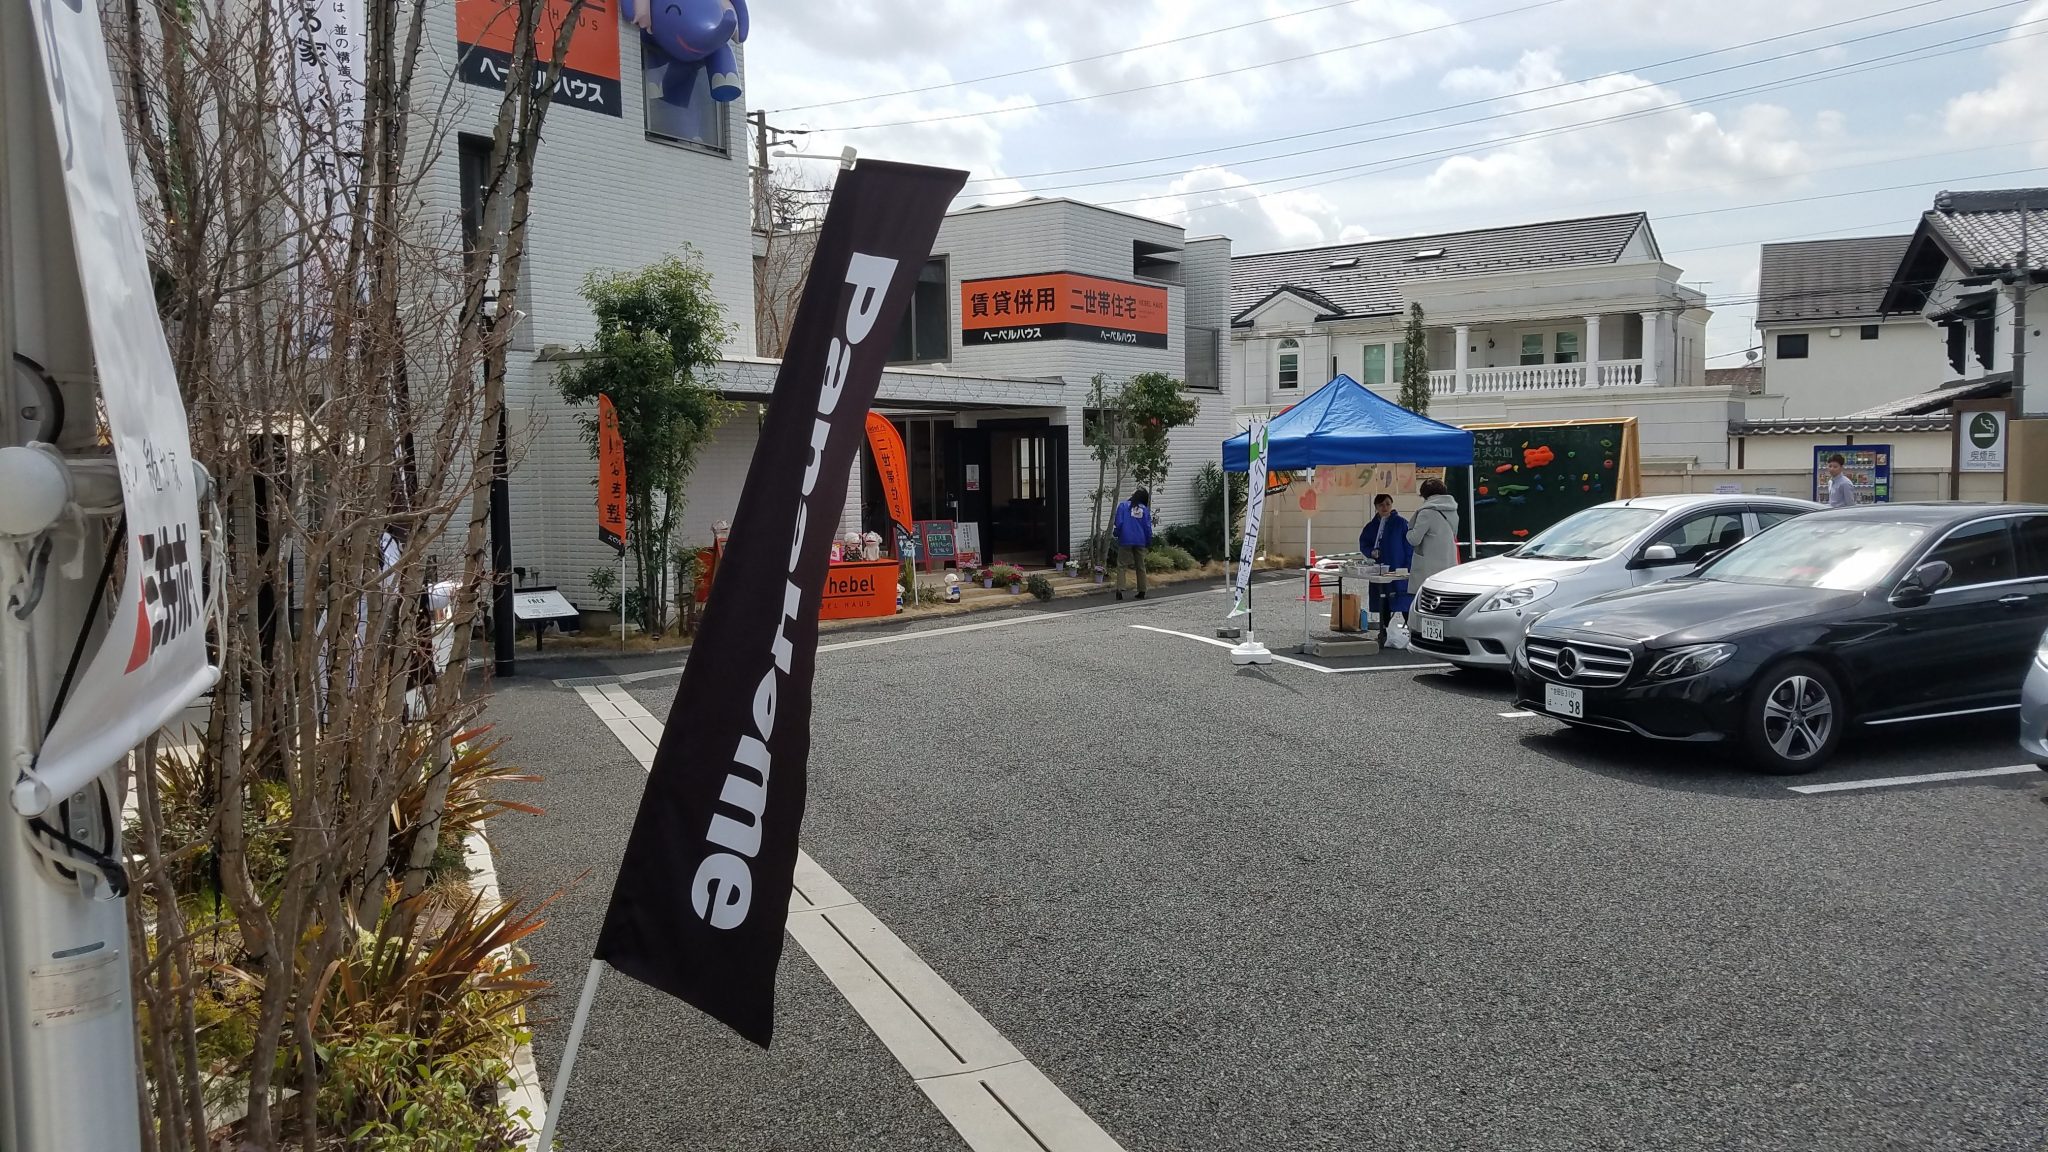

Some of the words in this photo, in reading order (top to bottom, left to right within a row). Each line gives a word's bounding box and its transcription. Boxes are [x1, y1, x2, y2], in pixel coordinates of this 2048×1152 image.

[552, 9, 598, 31] HUS
[480, 57, 604, 105] ヘールハウス
[970, 287, 1056, 318] 賃貸併用
[1070, 288, 1137, 320] 二世帯住宅
[983, 327, 1042, 342] ヘーベルハウス
[1100, 330, 1137, 344] ヘーベルハウス
[1969, 450, 1998, 460] 喫煙所
[828, 574, 876, 594] hebel
[844, 600, 871, 608] HAUS
[1568, 699, 1581, 715] 98
